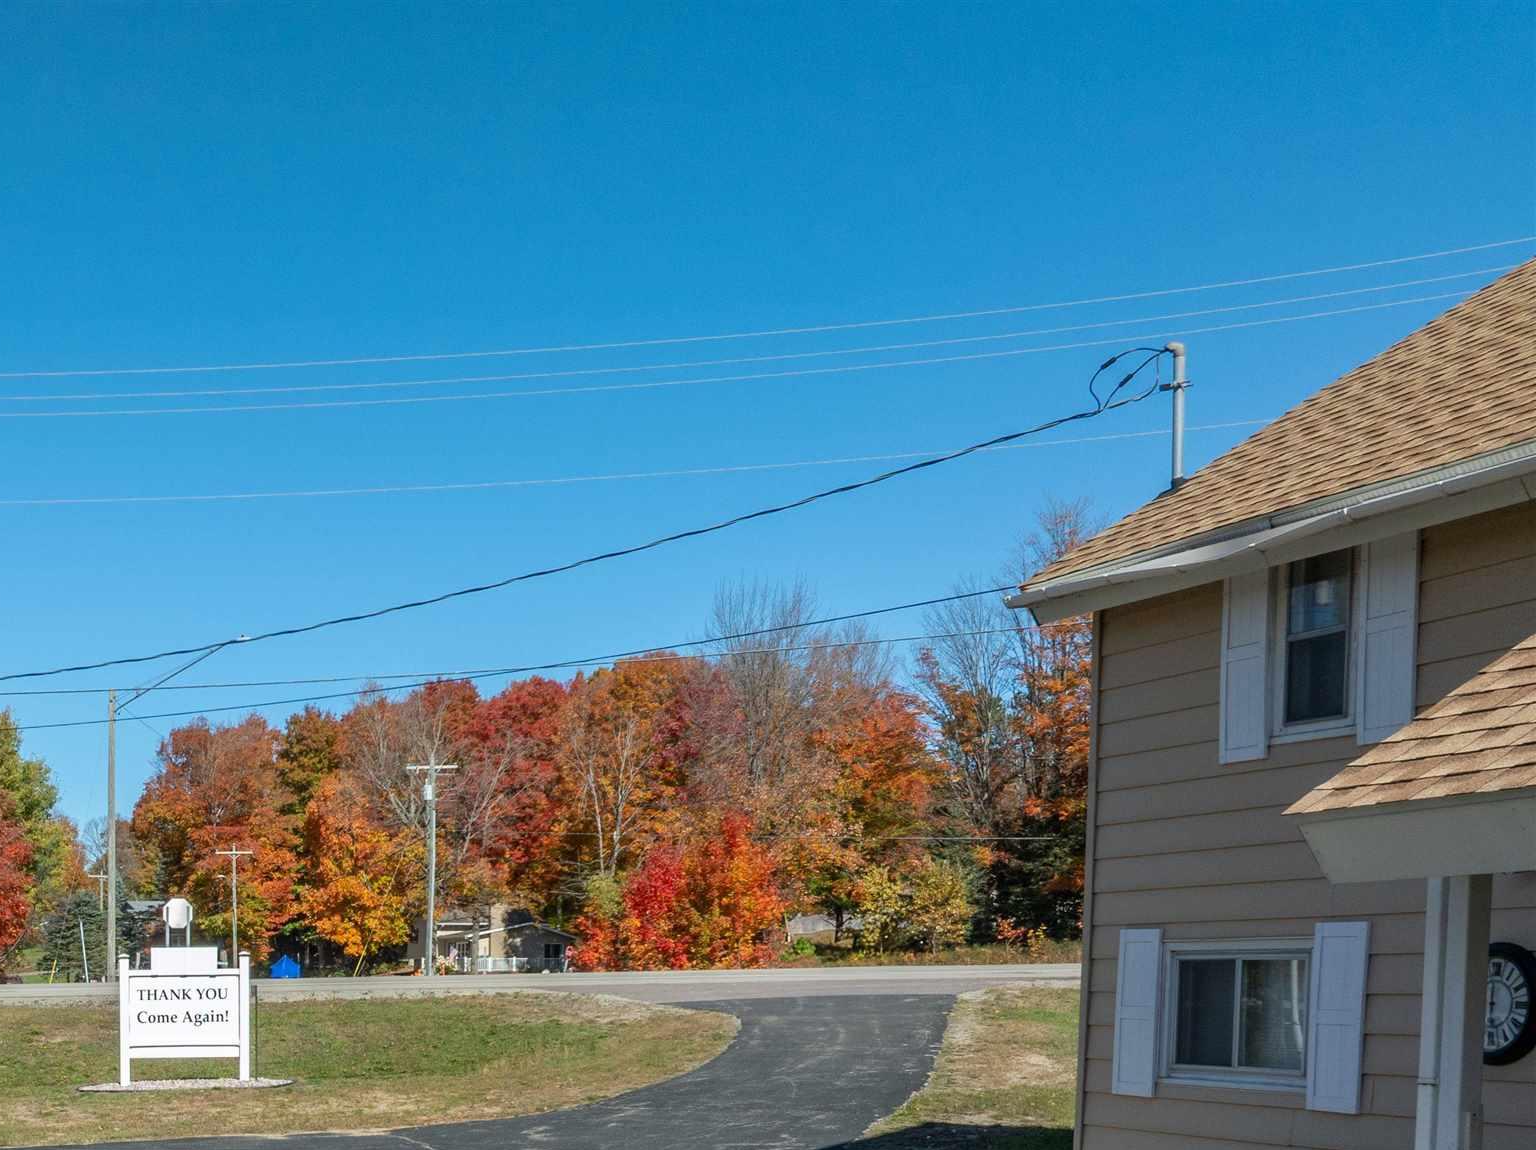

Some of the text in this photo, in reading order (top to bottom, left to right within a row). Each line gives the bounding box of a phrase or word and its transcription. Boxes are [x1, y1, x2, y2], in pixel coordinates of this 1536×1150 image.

[137, 987, 229, 1001] THANK YOU
[137, 1010, 229, 1026] Come Again!
